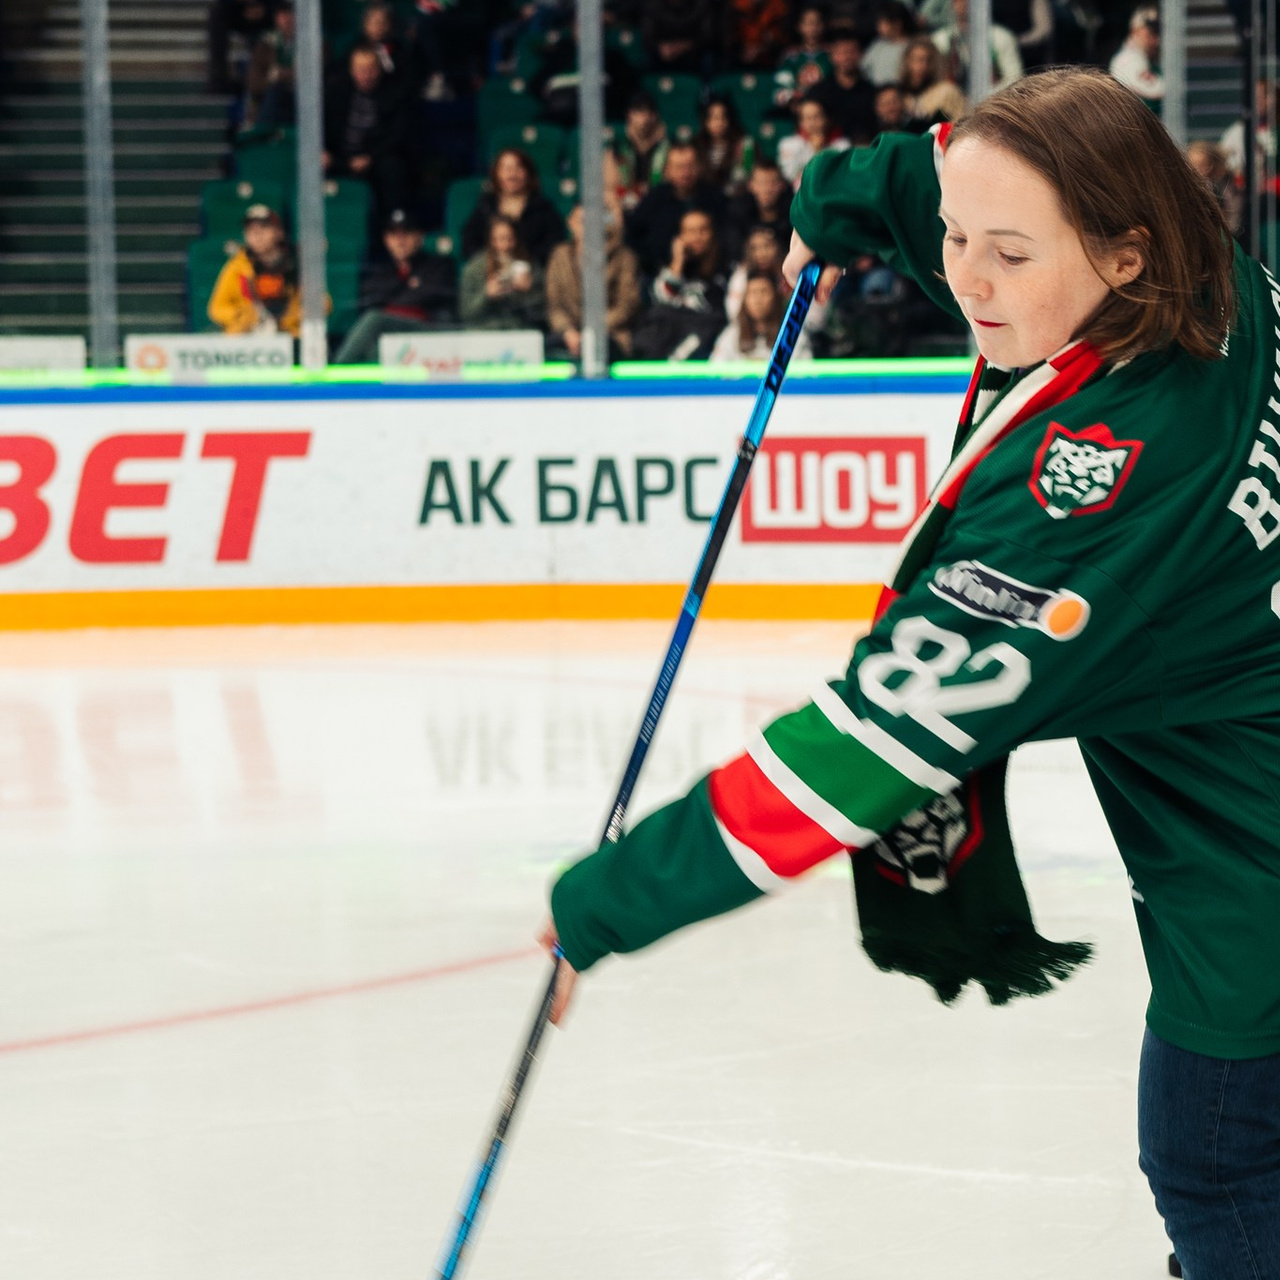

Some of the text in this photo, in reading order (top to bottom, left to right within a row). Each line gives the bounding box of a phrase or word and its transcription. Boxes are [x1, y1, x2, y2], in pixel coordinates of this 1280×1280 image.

[419, 451, 916, 529] АК БАРС ШОУ
[857, 615, 1032, 755] 82
